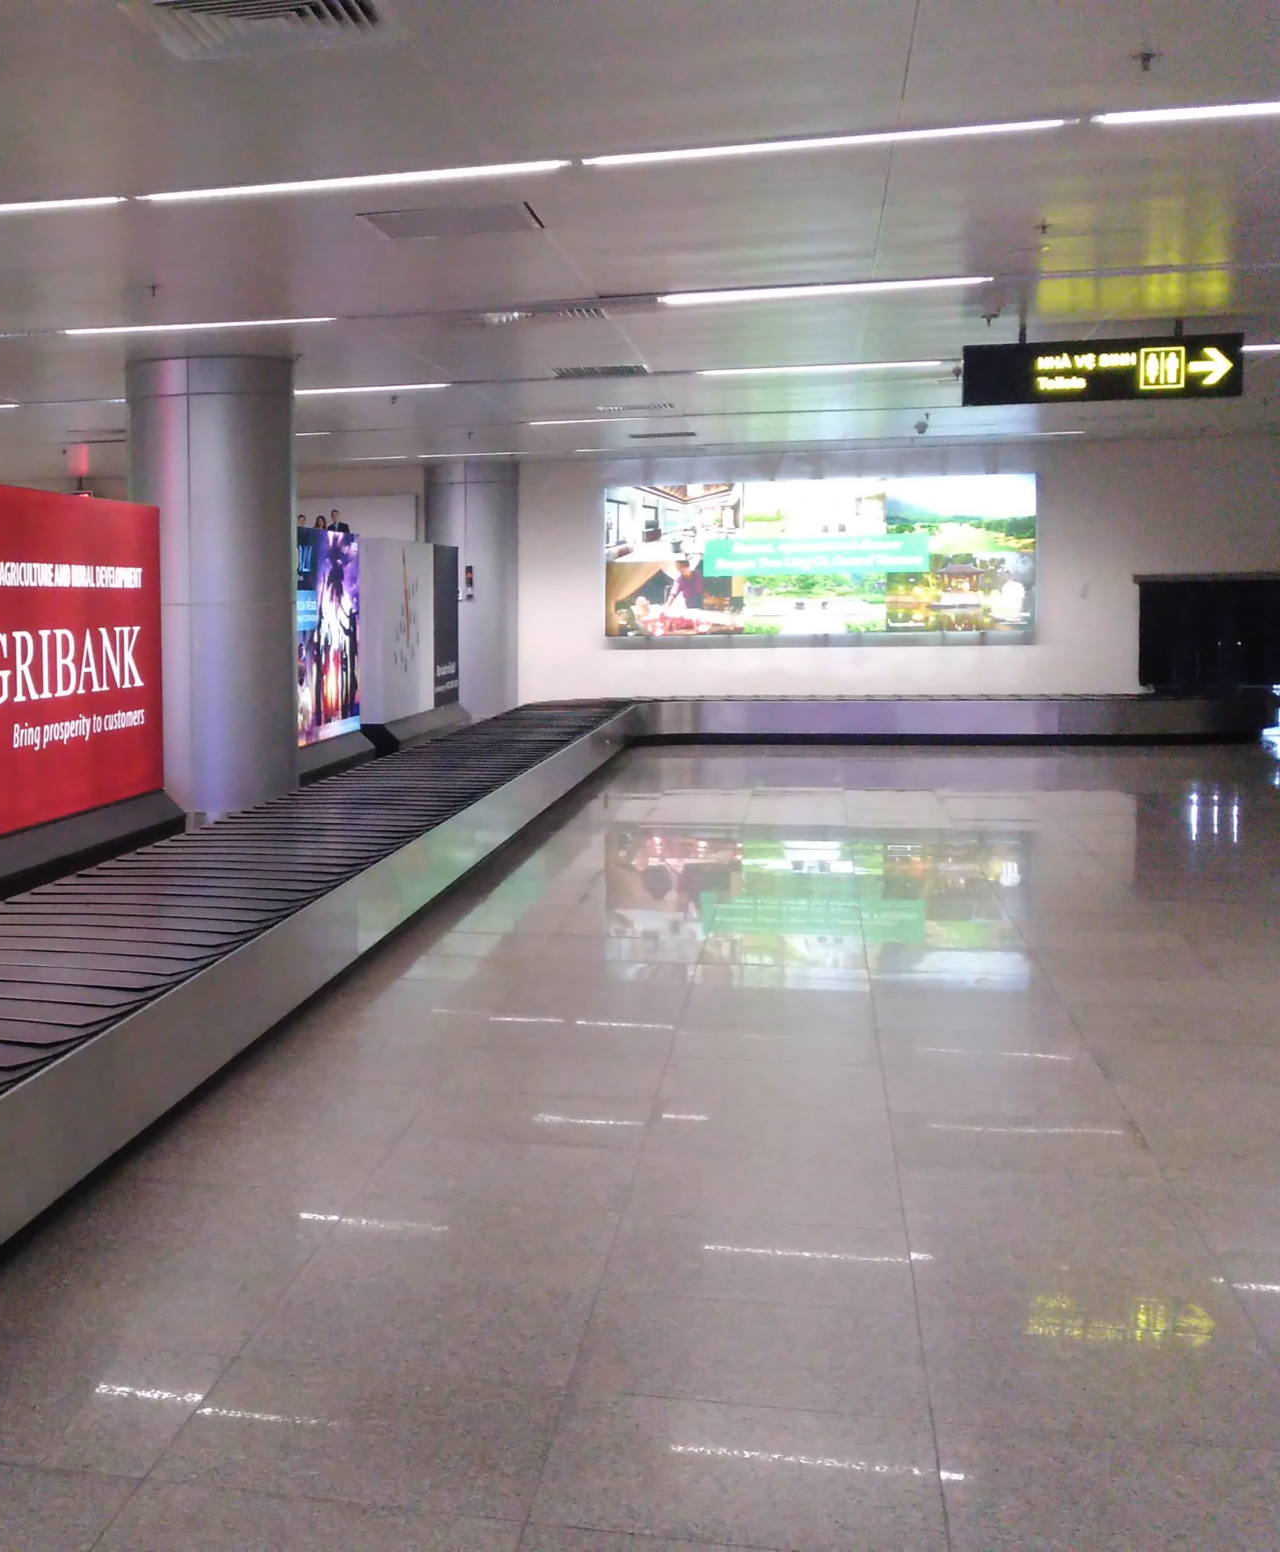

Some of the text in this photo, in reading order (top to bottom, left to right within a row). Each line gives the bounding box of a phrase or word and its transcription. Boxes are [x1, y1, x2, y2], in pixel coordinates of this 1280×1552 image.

[1098, 352, 1137, 368] SINH
[1036, 376, 1087, 390] Toilets
[54, 563, 71, 588] AND
[71, 563, 96, 589] RURAL
[95, 564, 143, 589] DEVELOPMENT
[12, 708, 145, 751] Bring prosperity to customers
